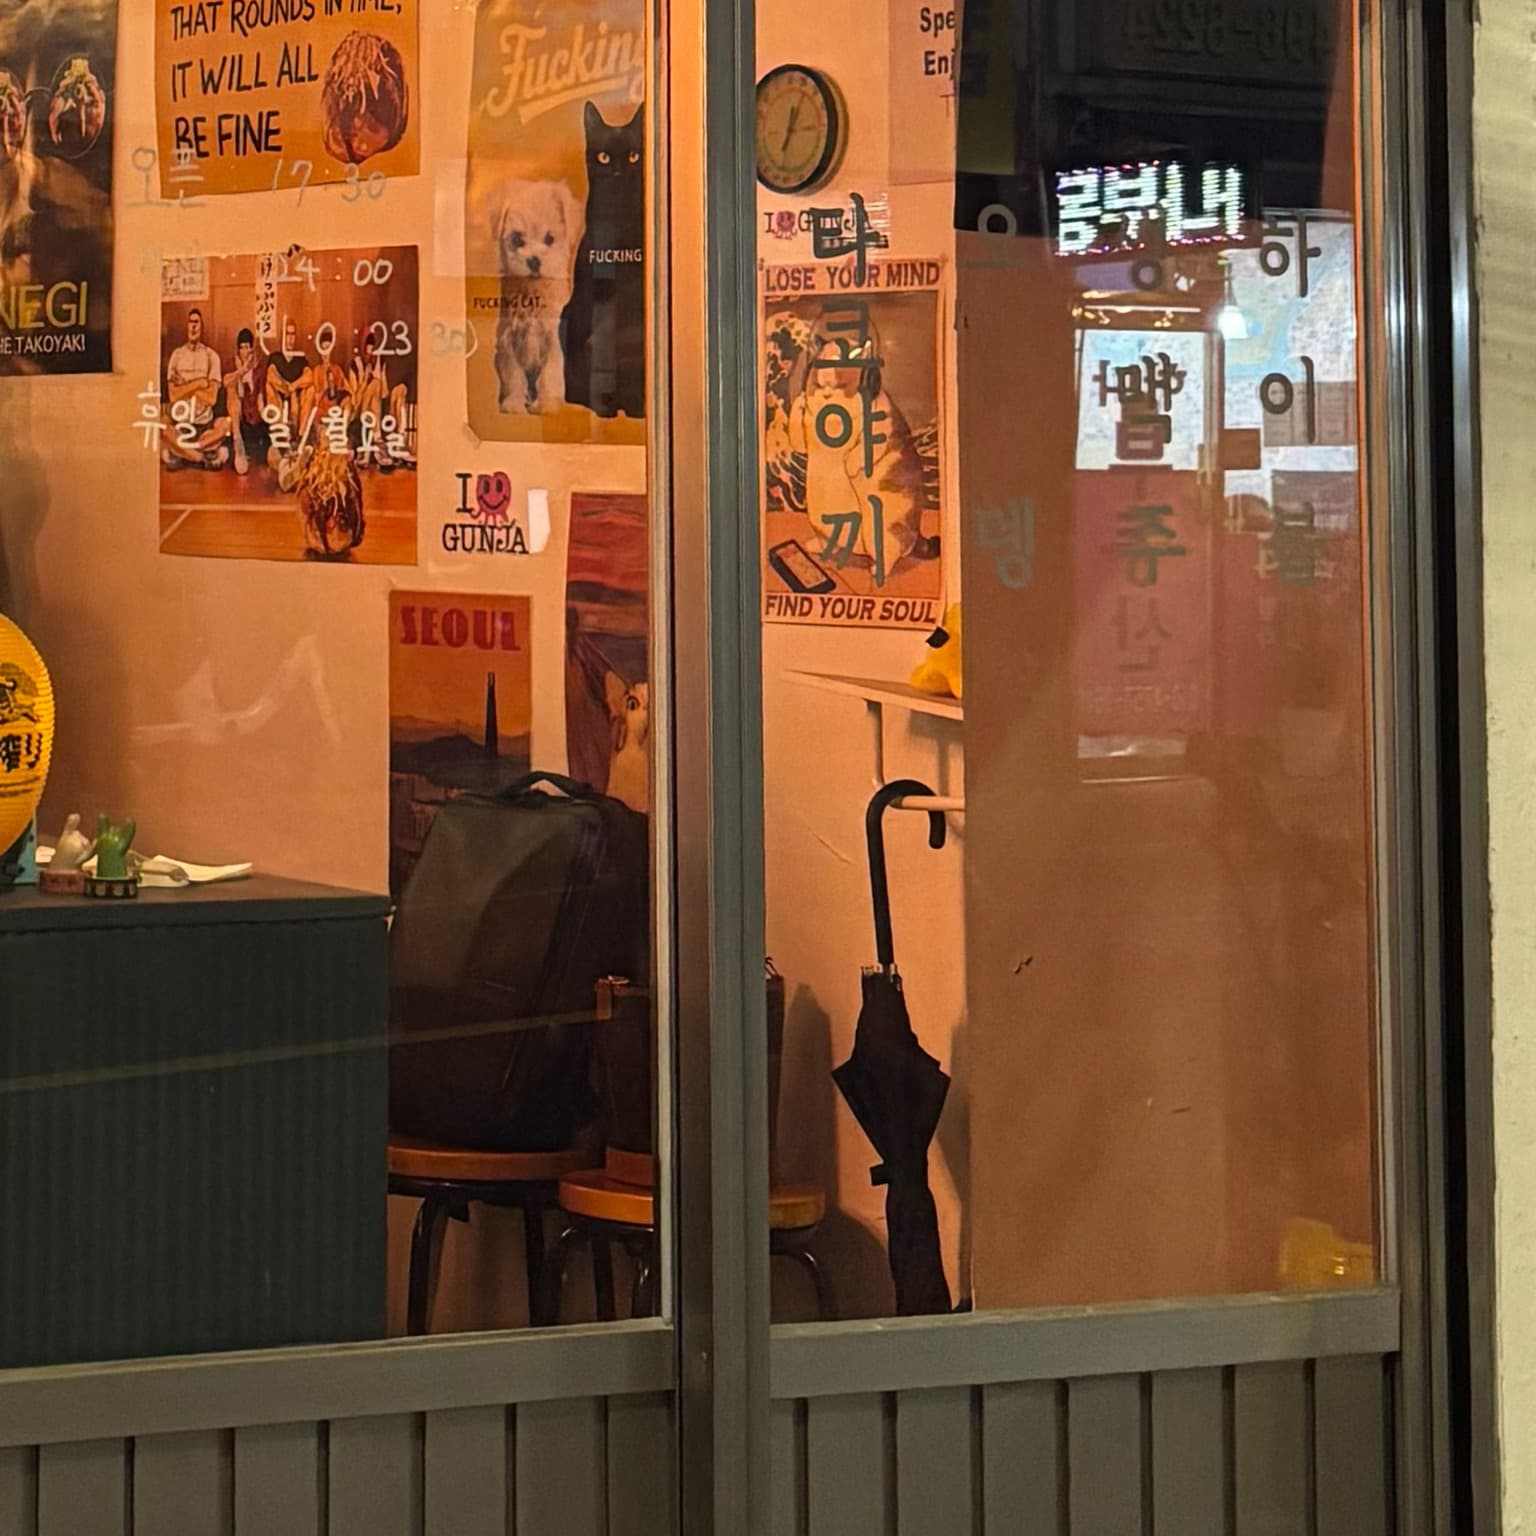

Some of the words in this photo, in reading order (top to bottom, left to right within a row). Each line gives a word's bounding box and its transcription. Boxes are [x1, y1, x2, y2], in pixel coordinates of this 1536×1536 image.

[170, 0, 224, 41] THAT
[171, 60, 193, 102] IT
[198, 53, 268, 95] WILL
[275, 41, 319, 88] ALL
[174, 115, 209, 161] BE
[216, 110, 283, 157] FINE
[588, 249, 643, 263] FUCKING
[765, 267, 816, 292] LOSE
[886, 262, 941, 288] MIND
[14, 332, 86, 355] TAKOYAKI
[455, 472, 473, 513] I
[442, 520, 529, 555] GUNJA
[399, 605, 521, 652] SEOUL
[765, 595, 815, 620] FIND
[819, 596, 877, 621] YOUR
[879, 598, 936, 624] SOUL
